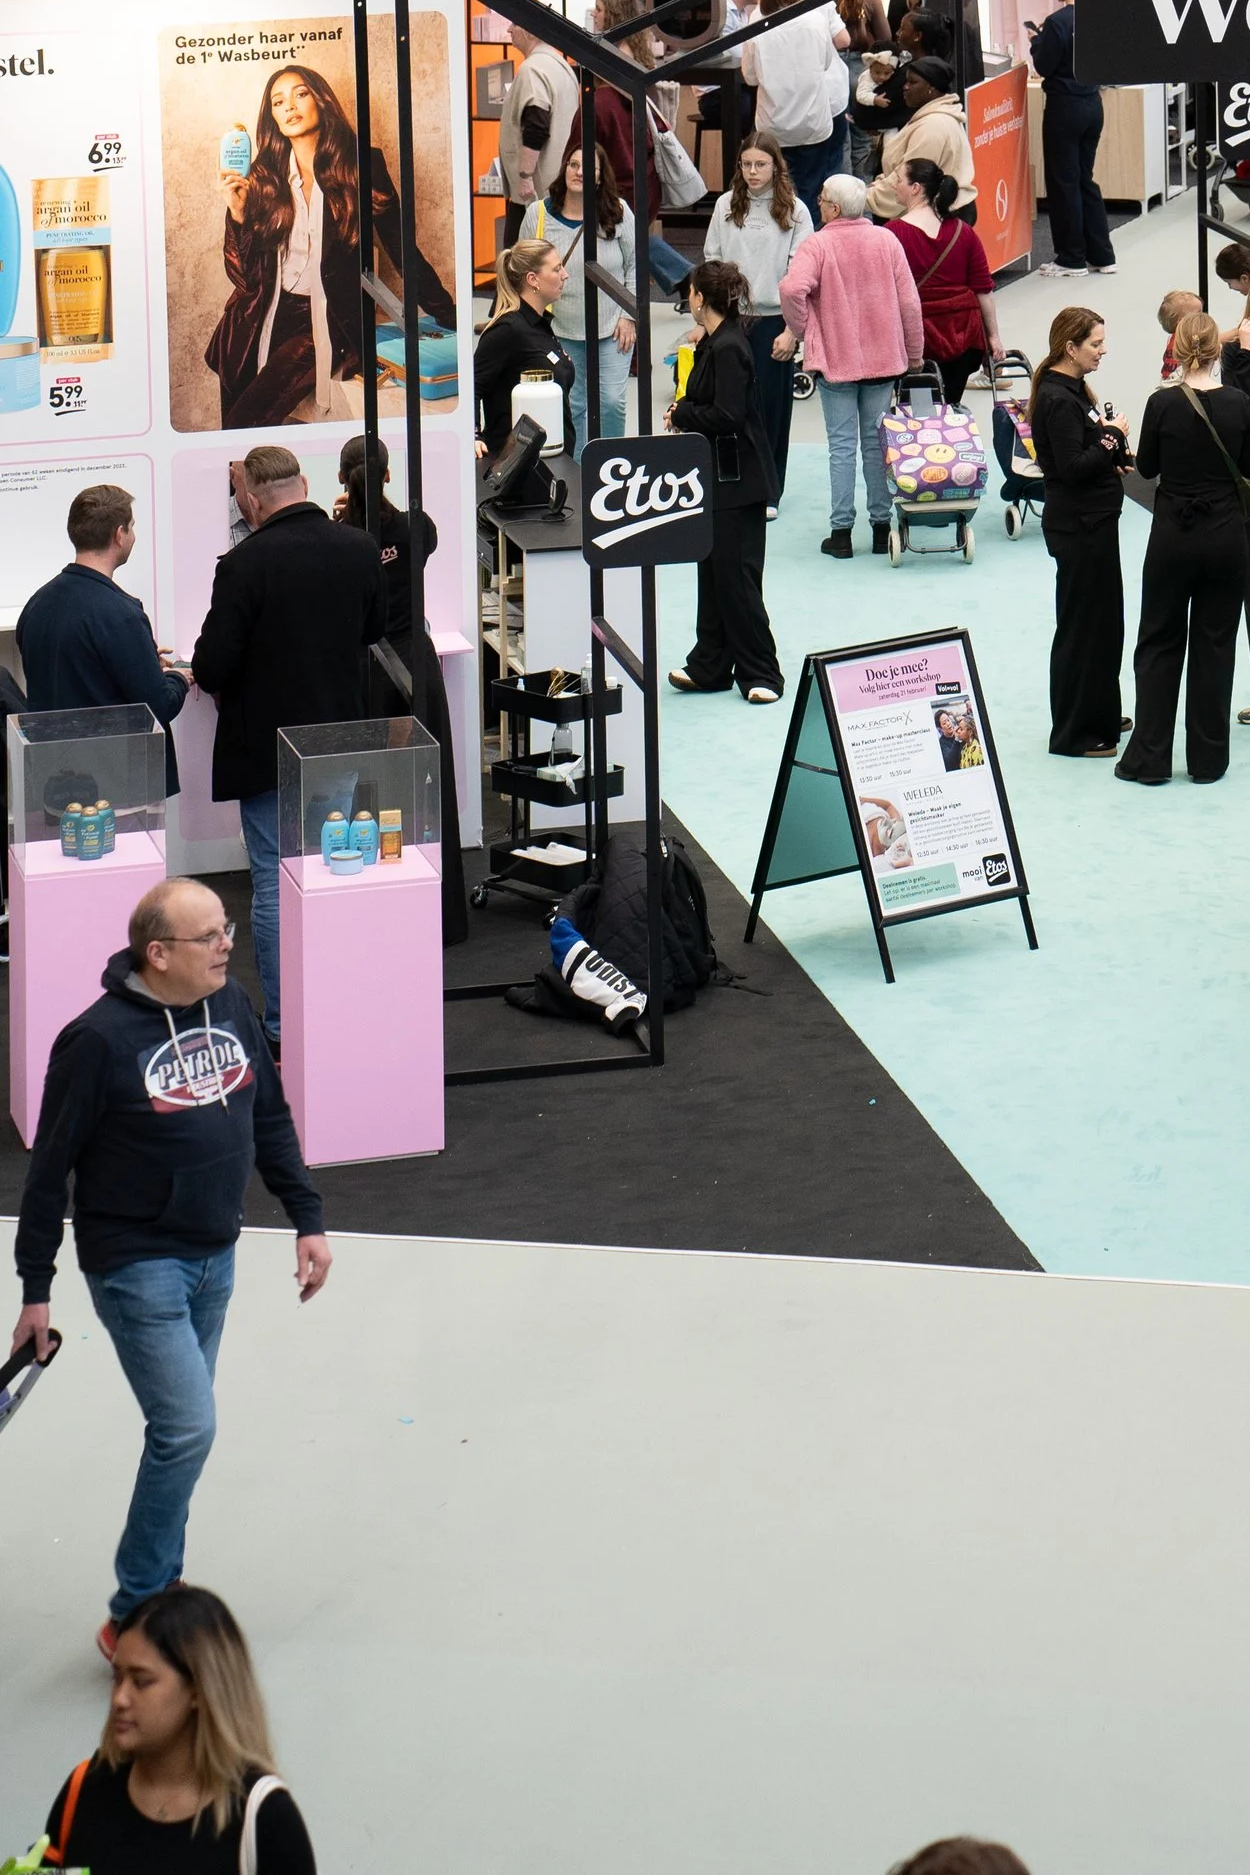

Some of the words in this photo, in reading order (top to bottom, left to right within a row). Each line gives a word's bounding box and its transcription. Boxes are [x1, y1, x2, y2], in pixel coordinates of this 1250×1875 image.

[175, 33, 254, 48] Gezonder
[259, 31, 295, 45] haar
[300, 27, 343, 42] vanaf
[176, 52, 195, 65] de
[37, 205, 71, 217] argan
[75, 201, 90, 212] oil
[55, 214, 107, 224] morocco
[44, 269, 73, 278] argan
[76, 266, 88, 275] oil
[59, 275, 102, 285] morocco
[591, 457, 704, 521] Etos
[889, 665, 900, 681] je
[859, 684, 876, 695] Volg
[875, 681, 890, 692] hier
[892, 680, 905, 689] een
[905, 672, 941, 686] workshop
[868, 716, 903, 728] FACTOR
[903, 785, 943, 801] WELEDA
[962, 866, 983, 879] mooi
[985, 859, 1008, 877] Etos
[158, 1042, 237, 1089] PETROL
